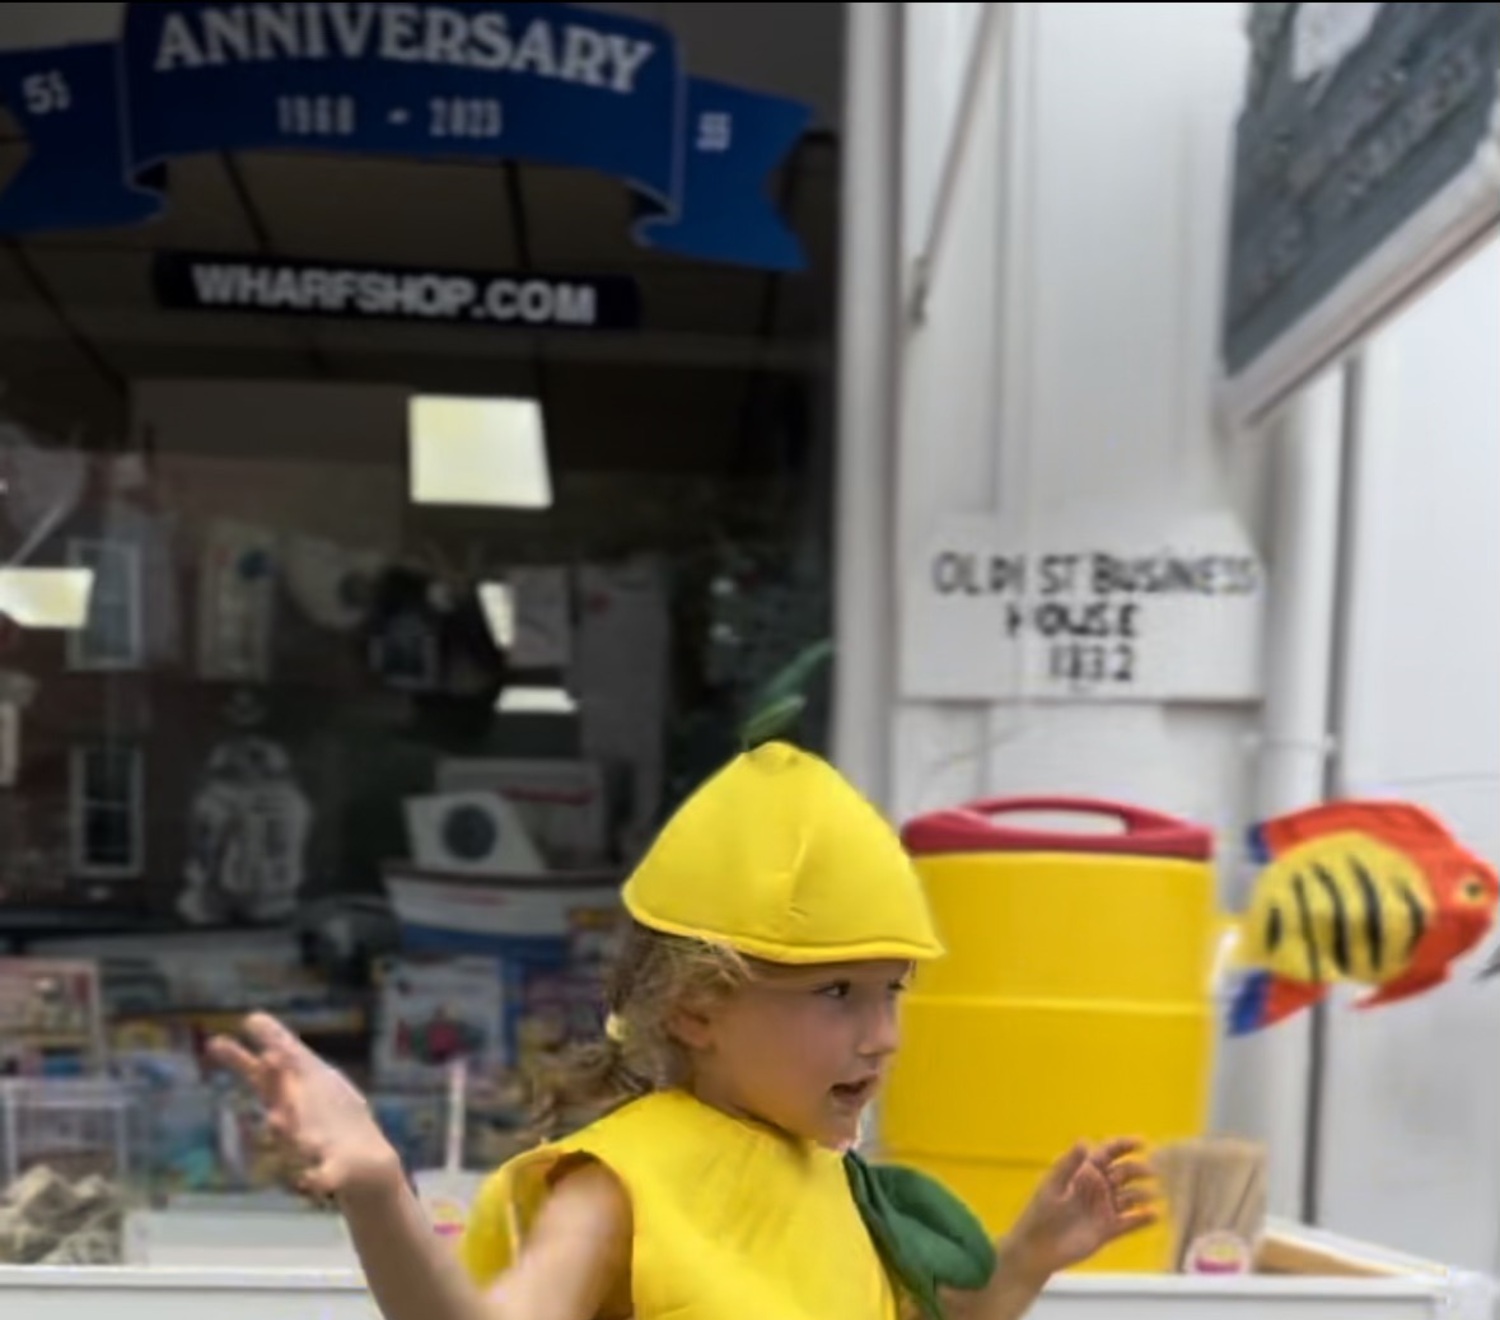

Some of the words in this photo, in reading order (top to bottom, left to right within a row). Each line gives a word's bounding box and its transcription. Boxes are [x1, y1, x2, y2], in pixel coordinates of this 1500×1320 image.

[153, 4, 655, 93] ANNIVERSARY
[427, 97, 503, 138] 2023
[191, 263, 596, 325] WHARFSHOP.COM
[1092, 551, 1258, 597] BUSINESS
